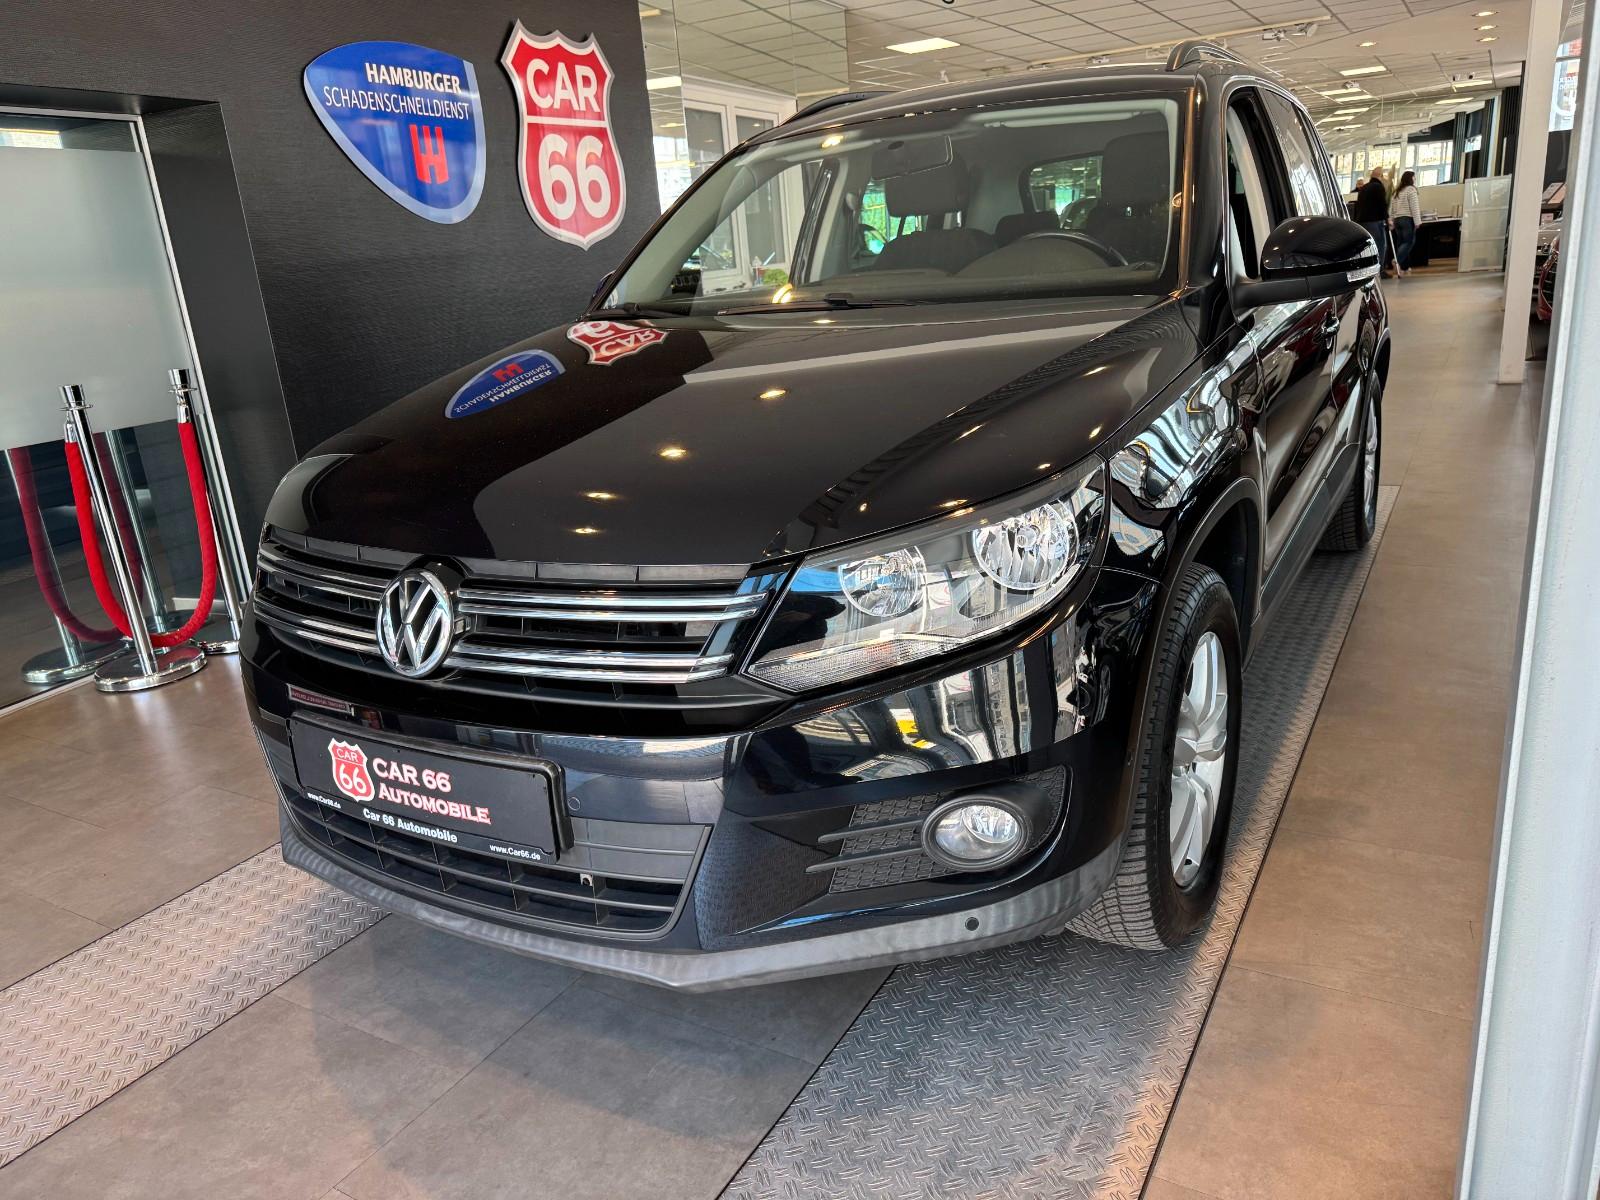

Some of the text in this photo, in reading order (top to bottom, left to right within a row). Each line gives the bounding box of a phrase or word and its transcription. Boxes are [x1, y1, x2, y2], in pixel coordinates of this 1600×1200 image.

[365, 62, 462, 95] HAMBURGER
[526, 58, 601, 113] CAR
[323, 86, 470, 121] SCHADENSCHNELLDIENST
[538, 134, 612, 221] 66
[336, 746, 358, 763] CAR
[337, 763, 368, 795] 66
[372, 757, 453, 793] CAR 66
[378, 783, 492, 825] AUTOMOBILE
[362, 807, 458, 843] Car 66 Automobile
[489, 844, 541, 861] www.Car66.de
